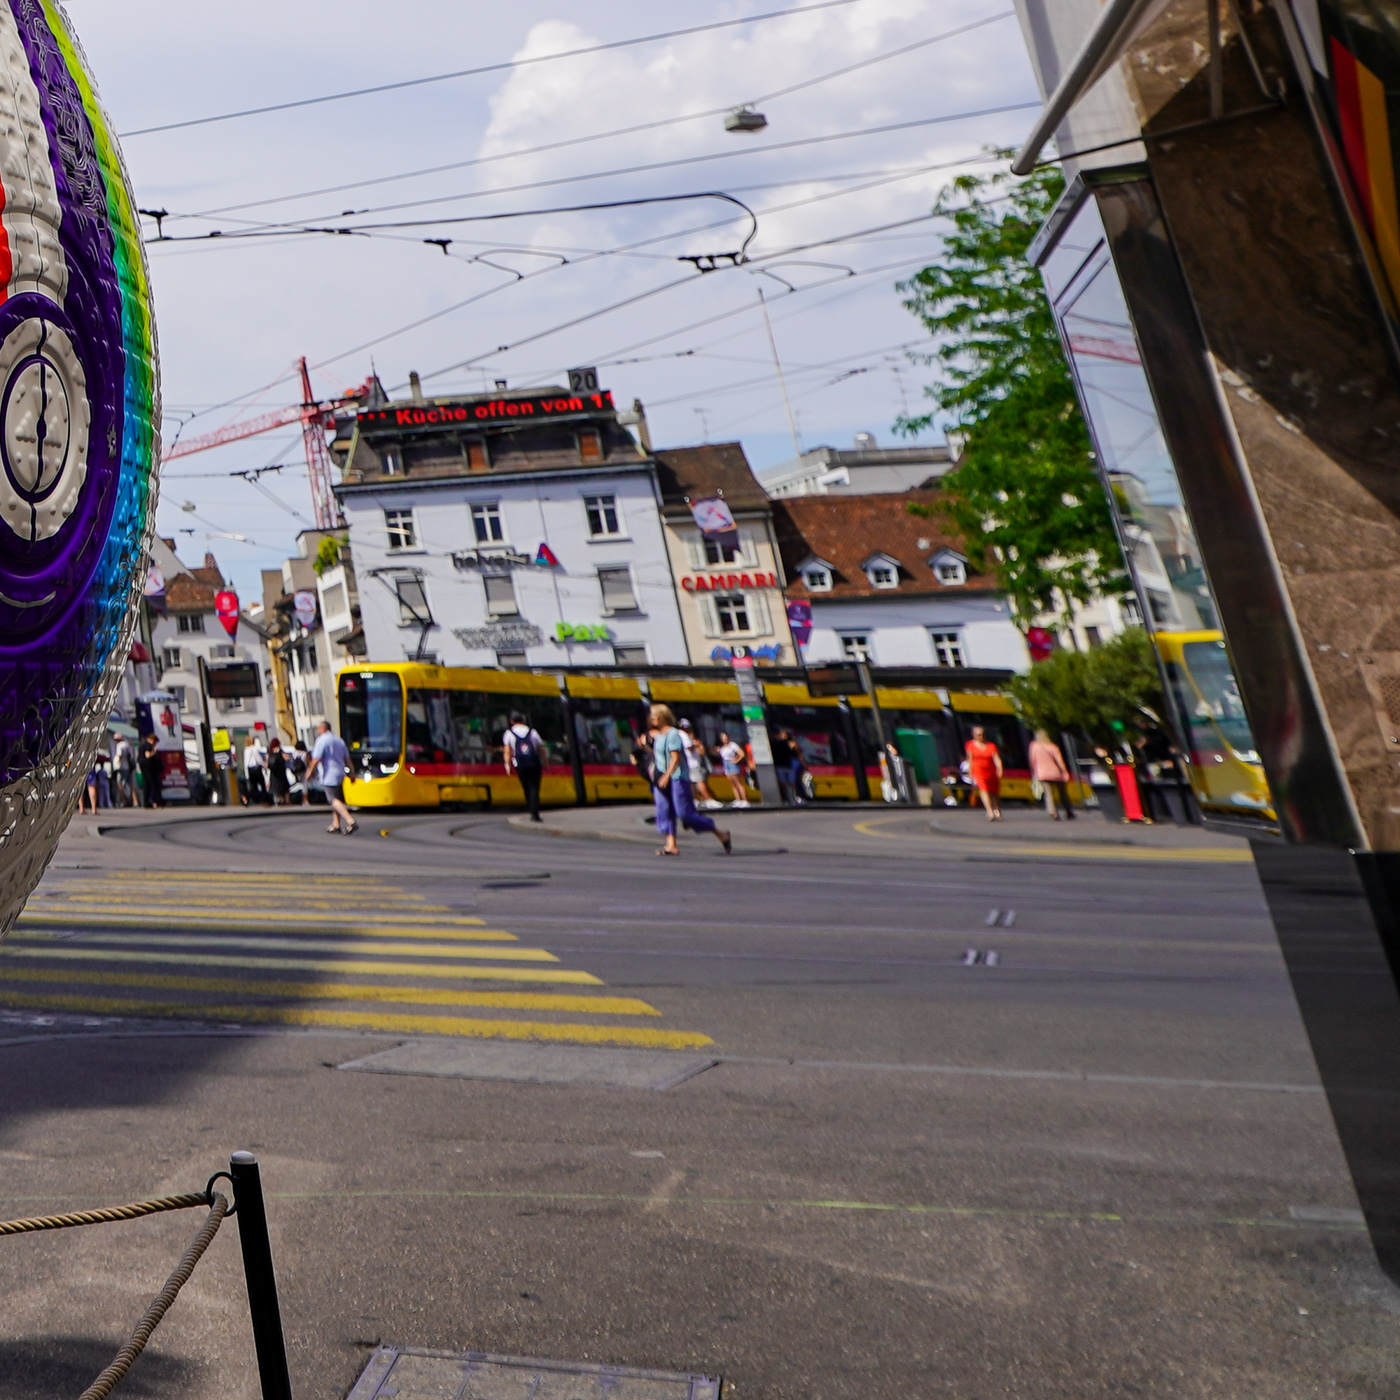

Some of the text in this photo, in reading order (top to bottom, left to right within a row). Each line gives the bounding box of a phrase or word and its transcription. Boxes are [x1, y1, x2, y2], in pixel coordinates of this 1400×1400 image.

[573, 372, 597, 392] 20
[396, 404, 467, 426] Küche
[475, 400, 534, 419] offen
[542, 396, 583, 413] von
[682, 572, 776, 591] CAMPARI
[555, 622, 609, 642] Pax
